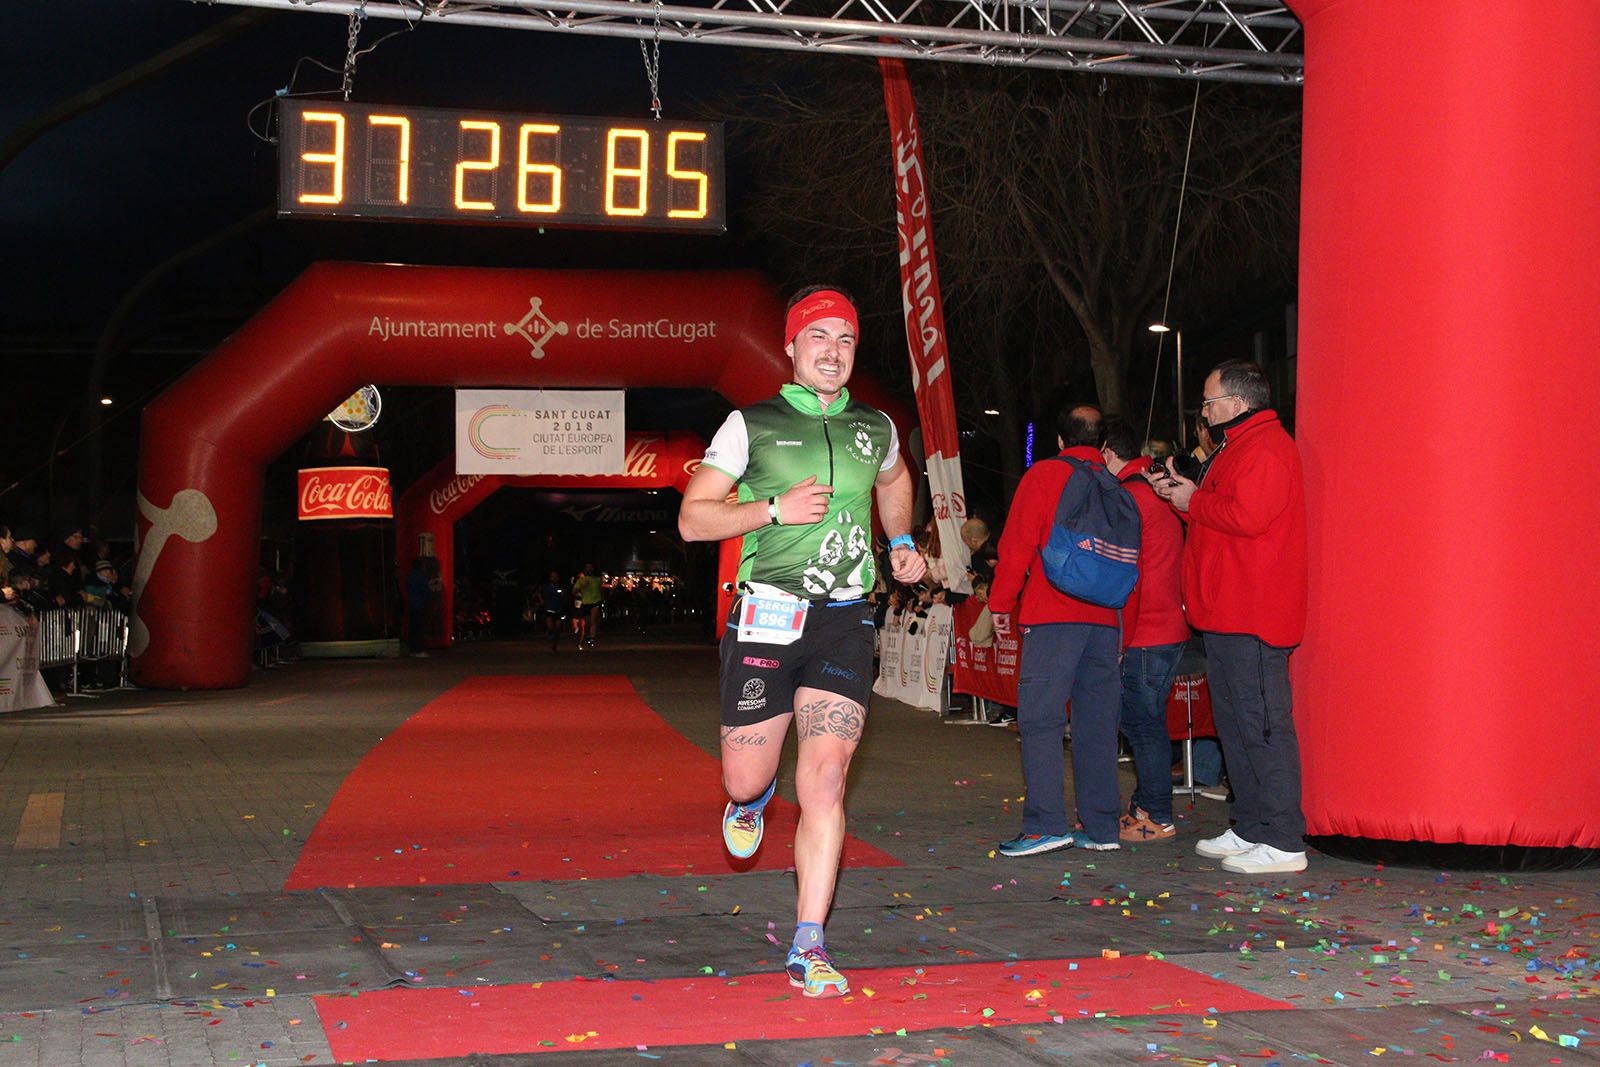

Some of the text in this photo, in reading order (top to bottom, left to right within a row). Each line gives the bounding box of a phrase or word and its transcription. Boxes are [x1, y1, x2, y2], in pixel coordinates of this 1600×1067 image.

[300, 111, 707, 219] 37 26 85
[368, 316, 717, 343] Ajuntament de SantCugat
[535, 410, 611, 420] SANT CUGAT
[553, 422, 593, 432] 2018
[532, 433, 613, 444] CIUTAT EUROPEA
[543, 445, 603, 456] DE L'ESPORT
[301, 475, 391, 514] Coca-Cola
[757, 600, 796, 613] SERGI
[758, 612, 788, 627] 896
[737, 697, 766, 706] AWESOME
[737, 702, 766, 711] COMMUNITY
